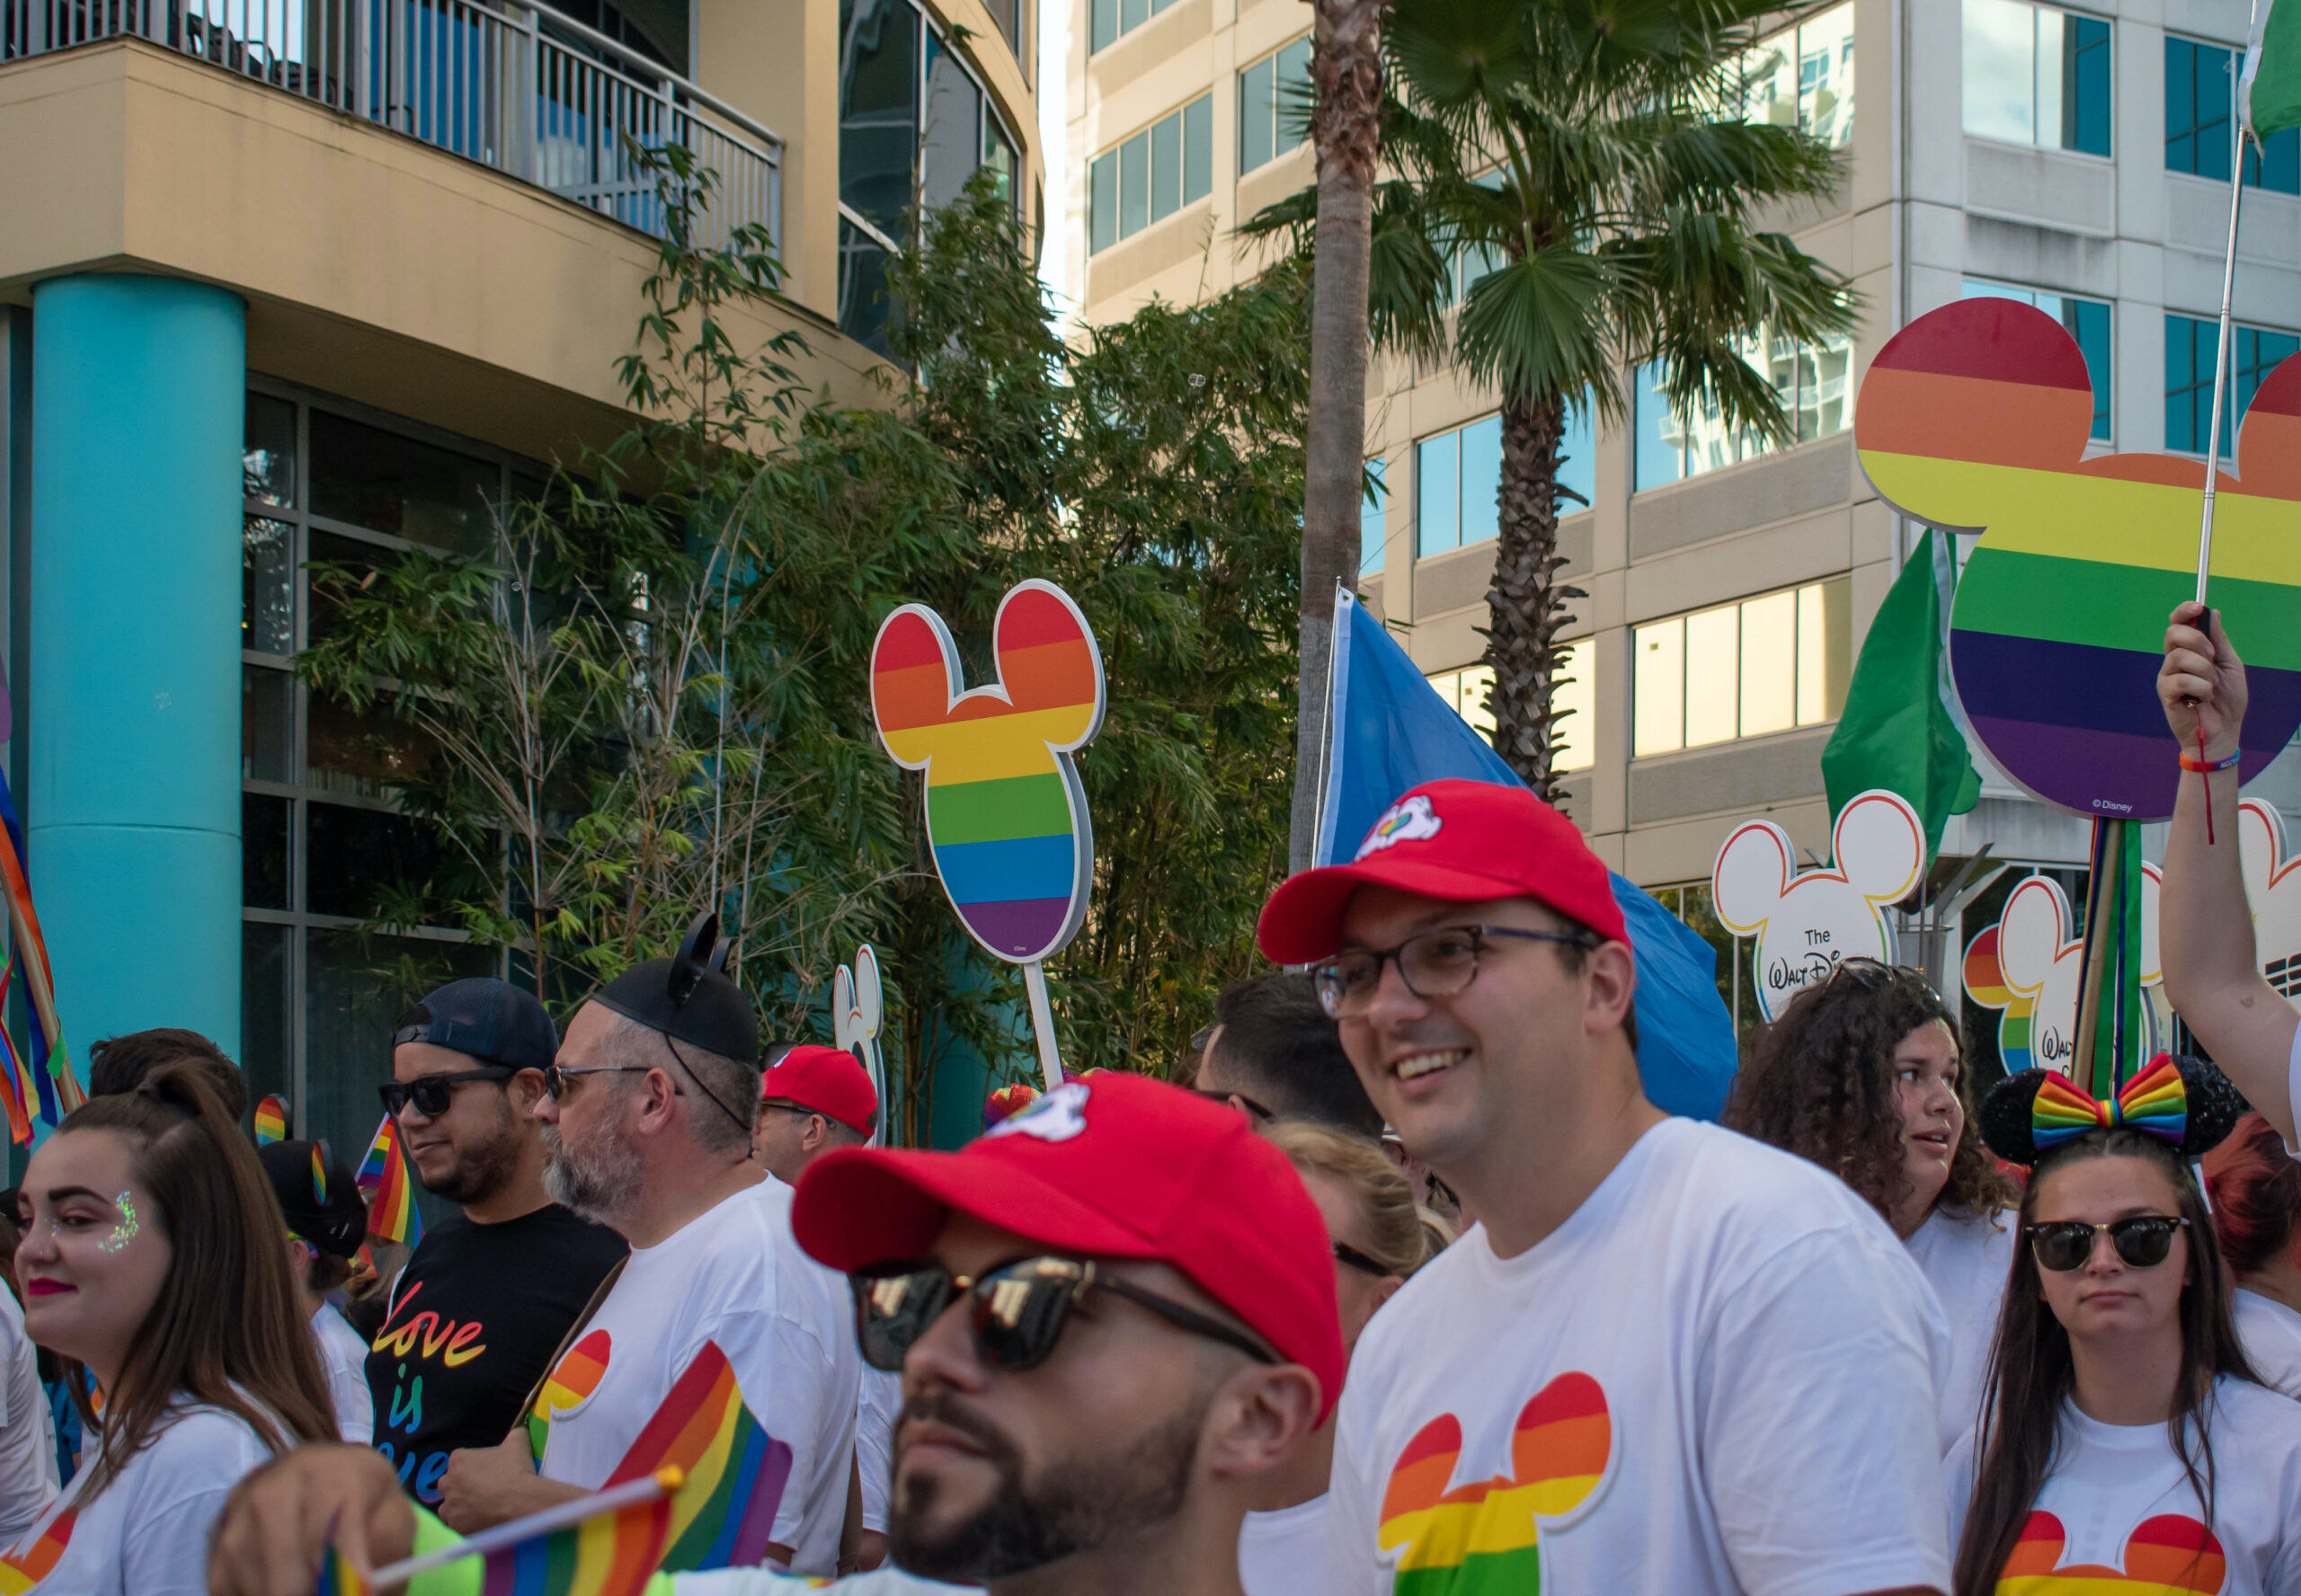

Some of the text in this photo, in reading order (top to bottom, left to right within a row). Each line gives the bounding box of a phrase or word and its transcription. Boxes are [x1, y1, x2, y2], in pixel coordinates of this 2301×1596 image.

[2102, 800, 2132, 813] Disney
[1805, 929, 1830, 946] The
[389, 1362, 422, 1434] is
